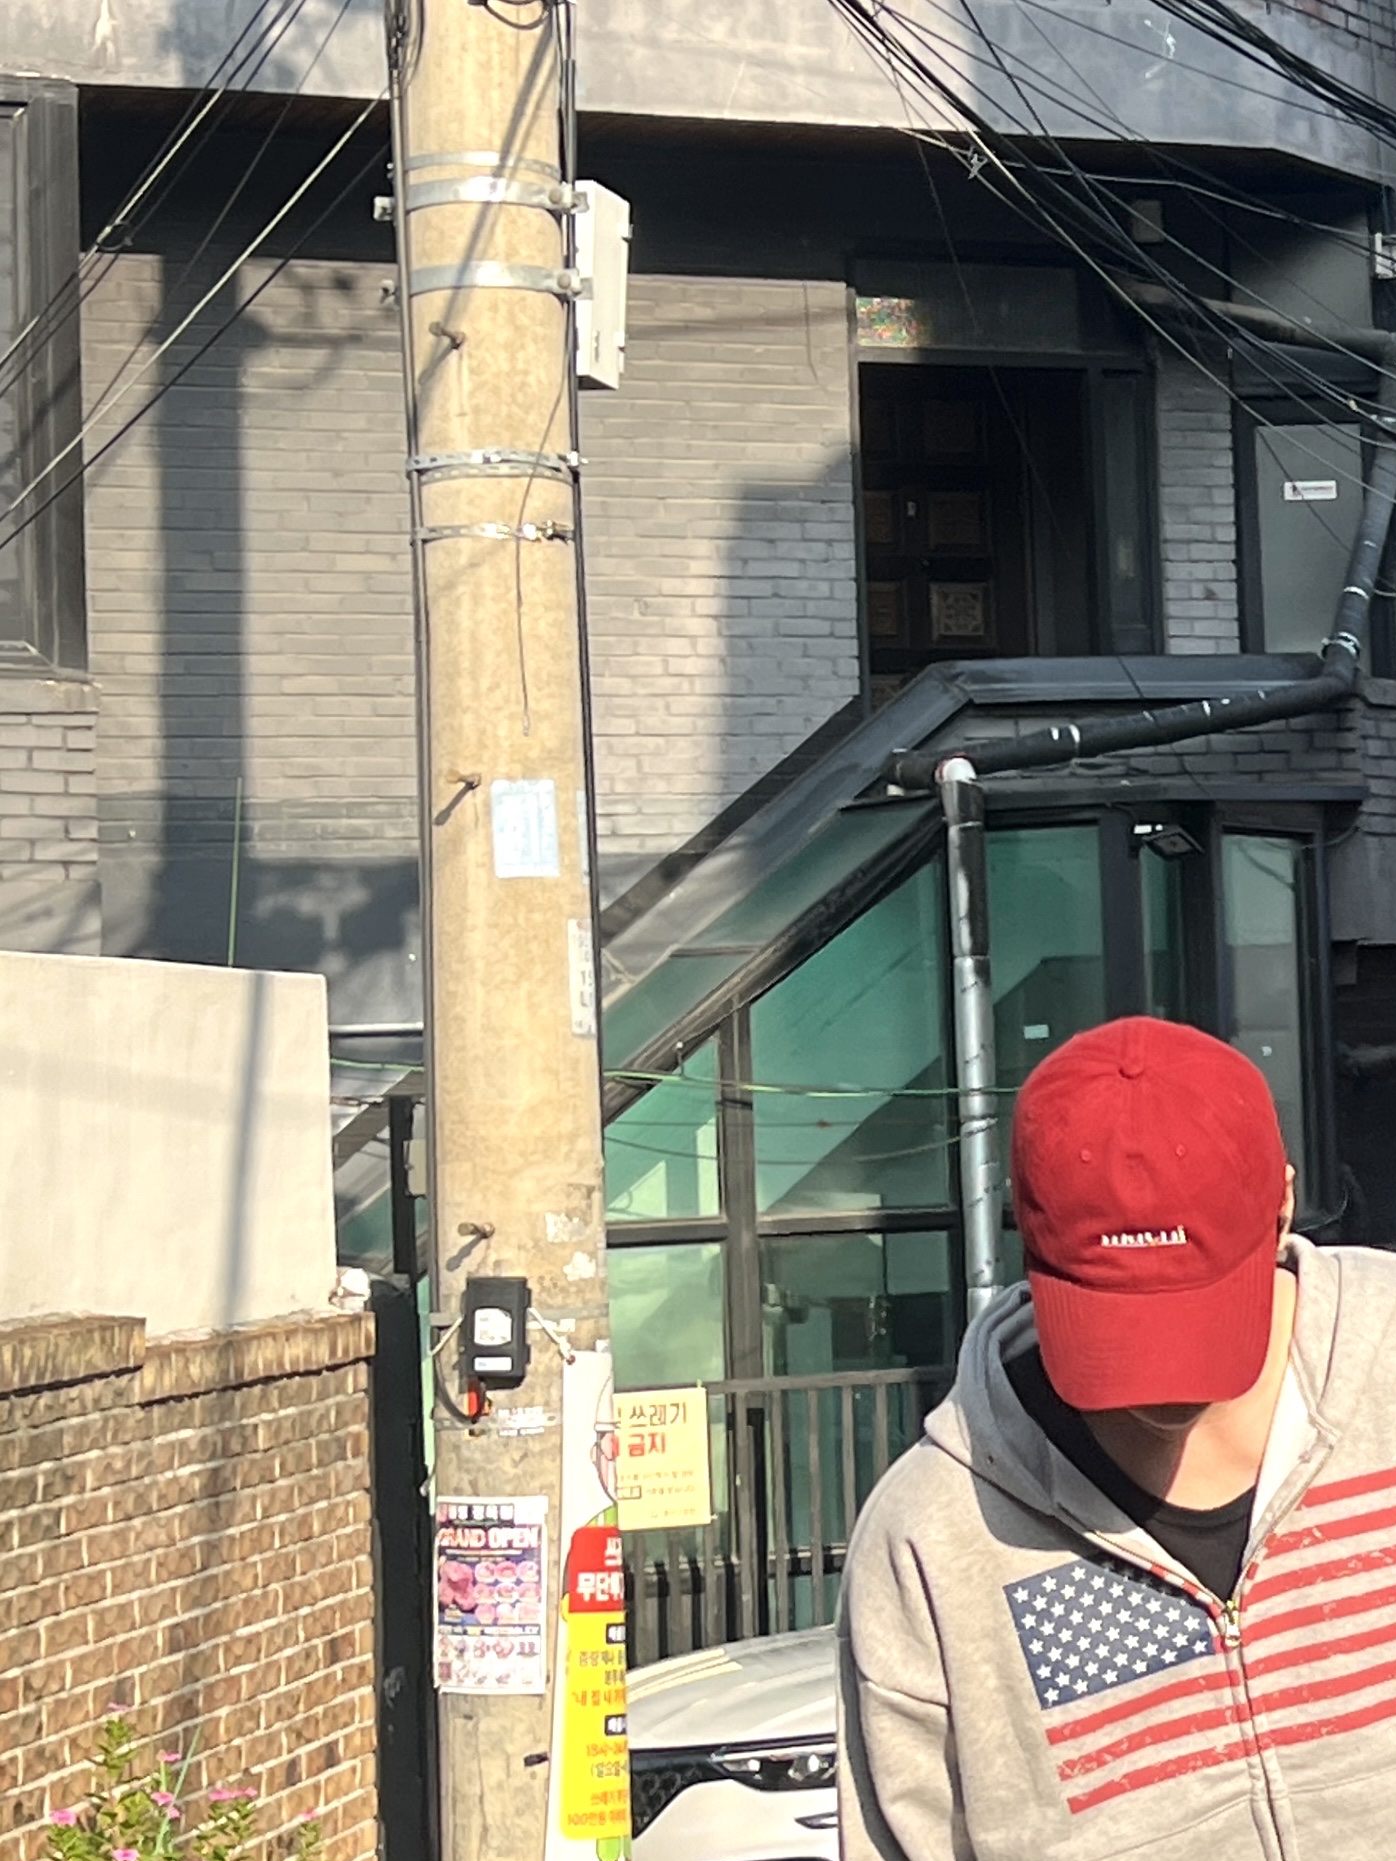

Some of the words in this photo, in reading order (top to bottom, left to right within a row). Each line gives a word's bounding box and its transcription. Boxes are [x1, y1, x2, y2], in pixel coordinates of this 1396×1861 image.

[629, 1402, 687, 1428] 쓰레기
[628, 1432, 666, 1457] 금지
[437, 1527, 486, 1549] GRAND
[488, 1526, 540, 1549] OPEN
